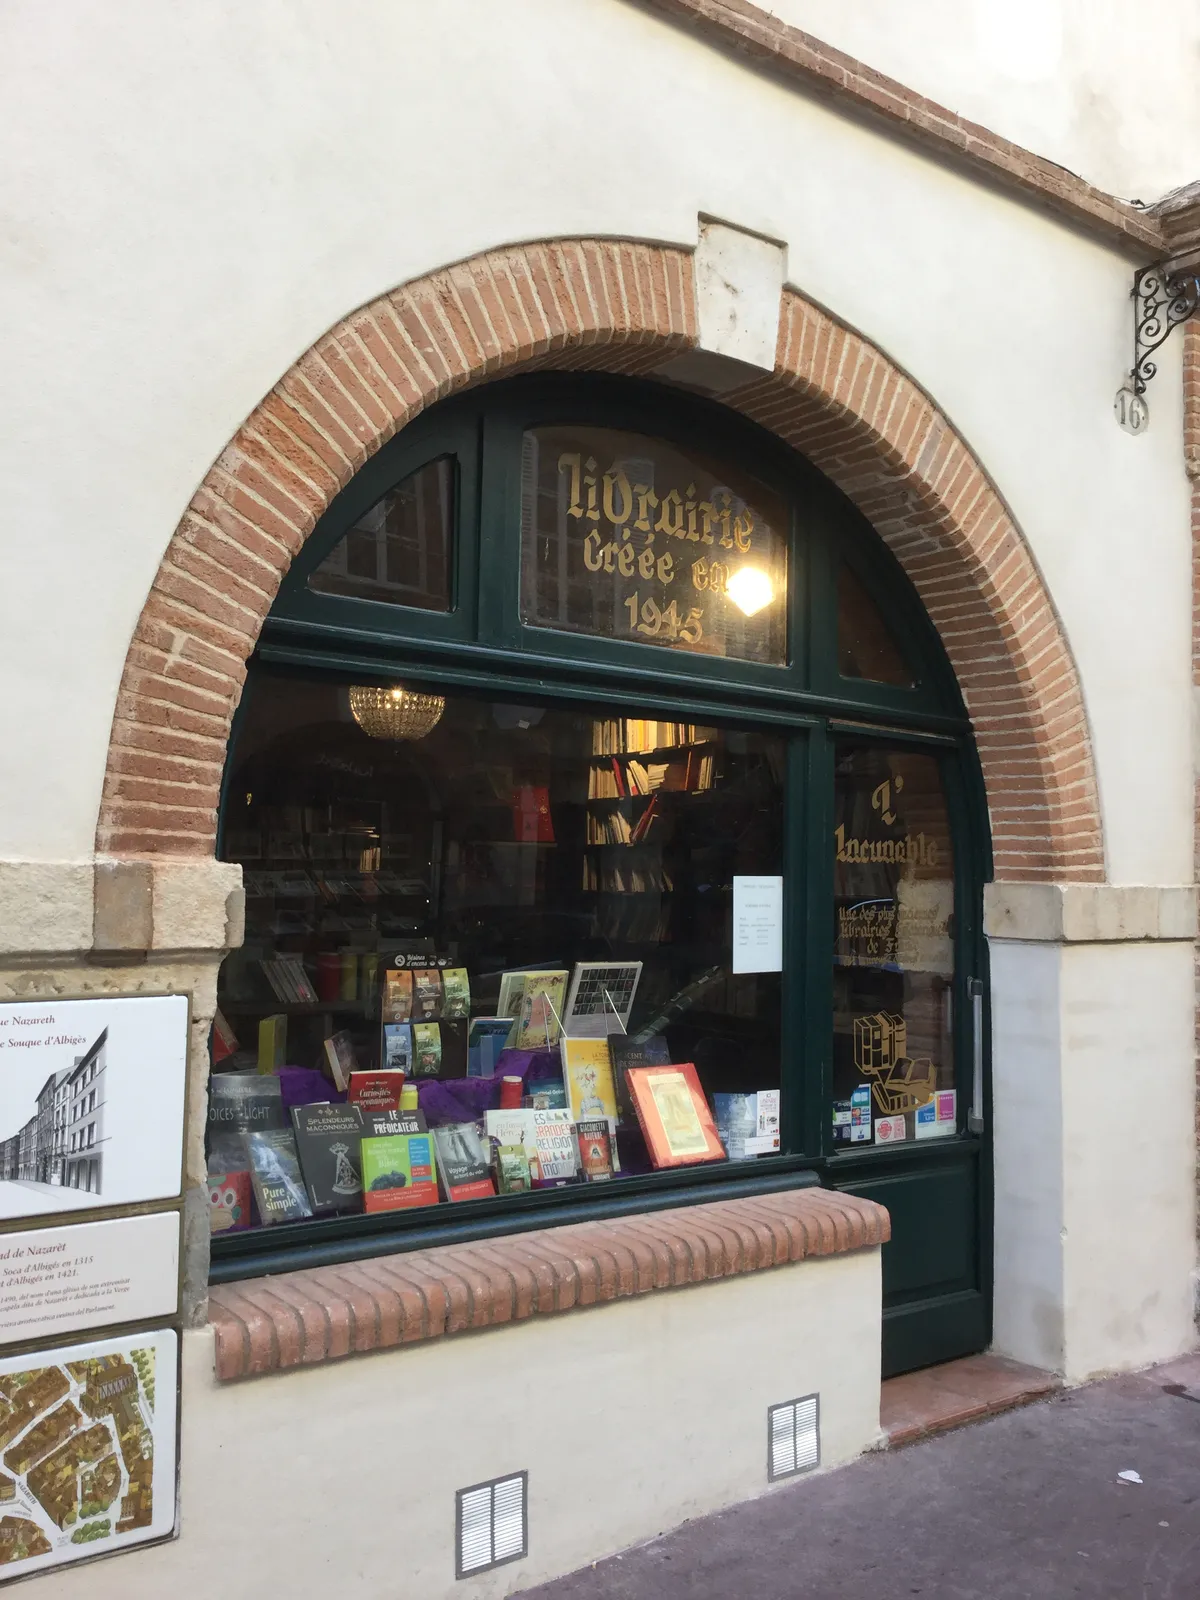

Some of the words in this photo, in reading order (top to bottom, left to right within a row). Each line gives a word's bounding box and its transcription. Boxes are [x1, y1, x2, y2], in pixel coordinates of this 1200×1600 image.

[1120, 395, 1141, 429] 16
[584, 529, 674, 584] Créée
[691, 556, 730, 594] en
[624, 591, 704, 644] 1945
[12, 1015, 55, 1026] Nazareth
[8, 1038, 41, 1049] Souque
[44, 1035, 86, 1046] d'Albigès
[360, 1088, 391, 1098] Curiosités
[308, 1116, 355, 1125] SPLENDEURS
[389, 1110, 399, 1121] LE
[306, 1123, 360, 1132] MAÇONNIQUES
[373, 1122, 420, 1134] PRÉDICATEUR
[539, 1151, 552, 1163] DU
[448, 1166, 468, 1175] Voyage
[262, 1187, 286, 1199] Pure
[265, 1195, 297, 1212] simple
[12, 1248, 25, 1259] de
[27, 1243, 67, 1256] Nazarèt
[3, 1267, 22, 1276] Soca
[24, 1261, 60, 1273] d'Albigés
[74, 1256, 94, 1266] 1315
[6, 1276, 43, 1287] d'Albigés
[57, 1269, 79, 1279] 1421.
[19, 1293, 29, 1301] del
[44, 1296, 68, 1305] Nazarèt
[74, 1290, 100, 1300] dedicada
[75, 1308, 85, 1316] del
